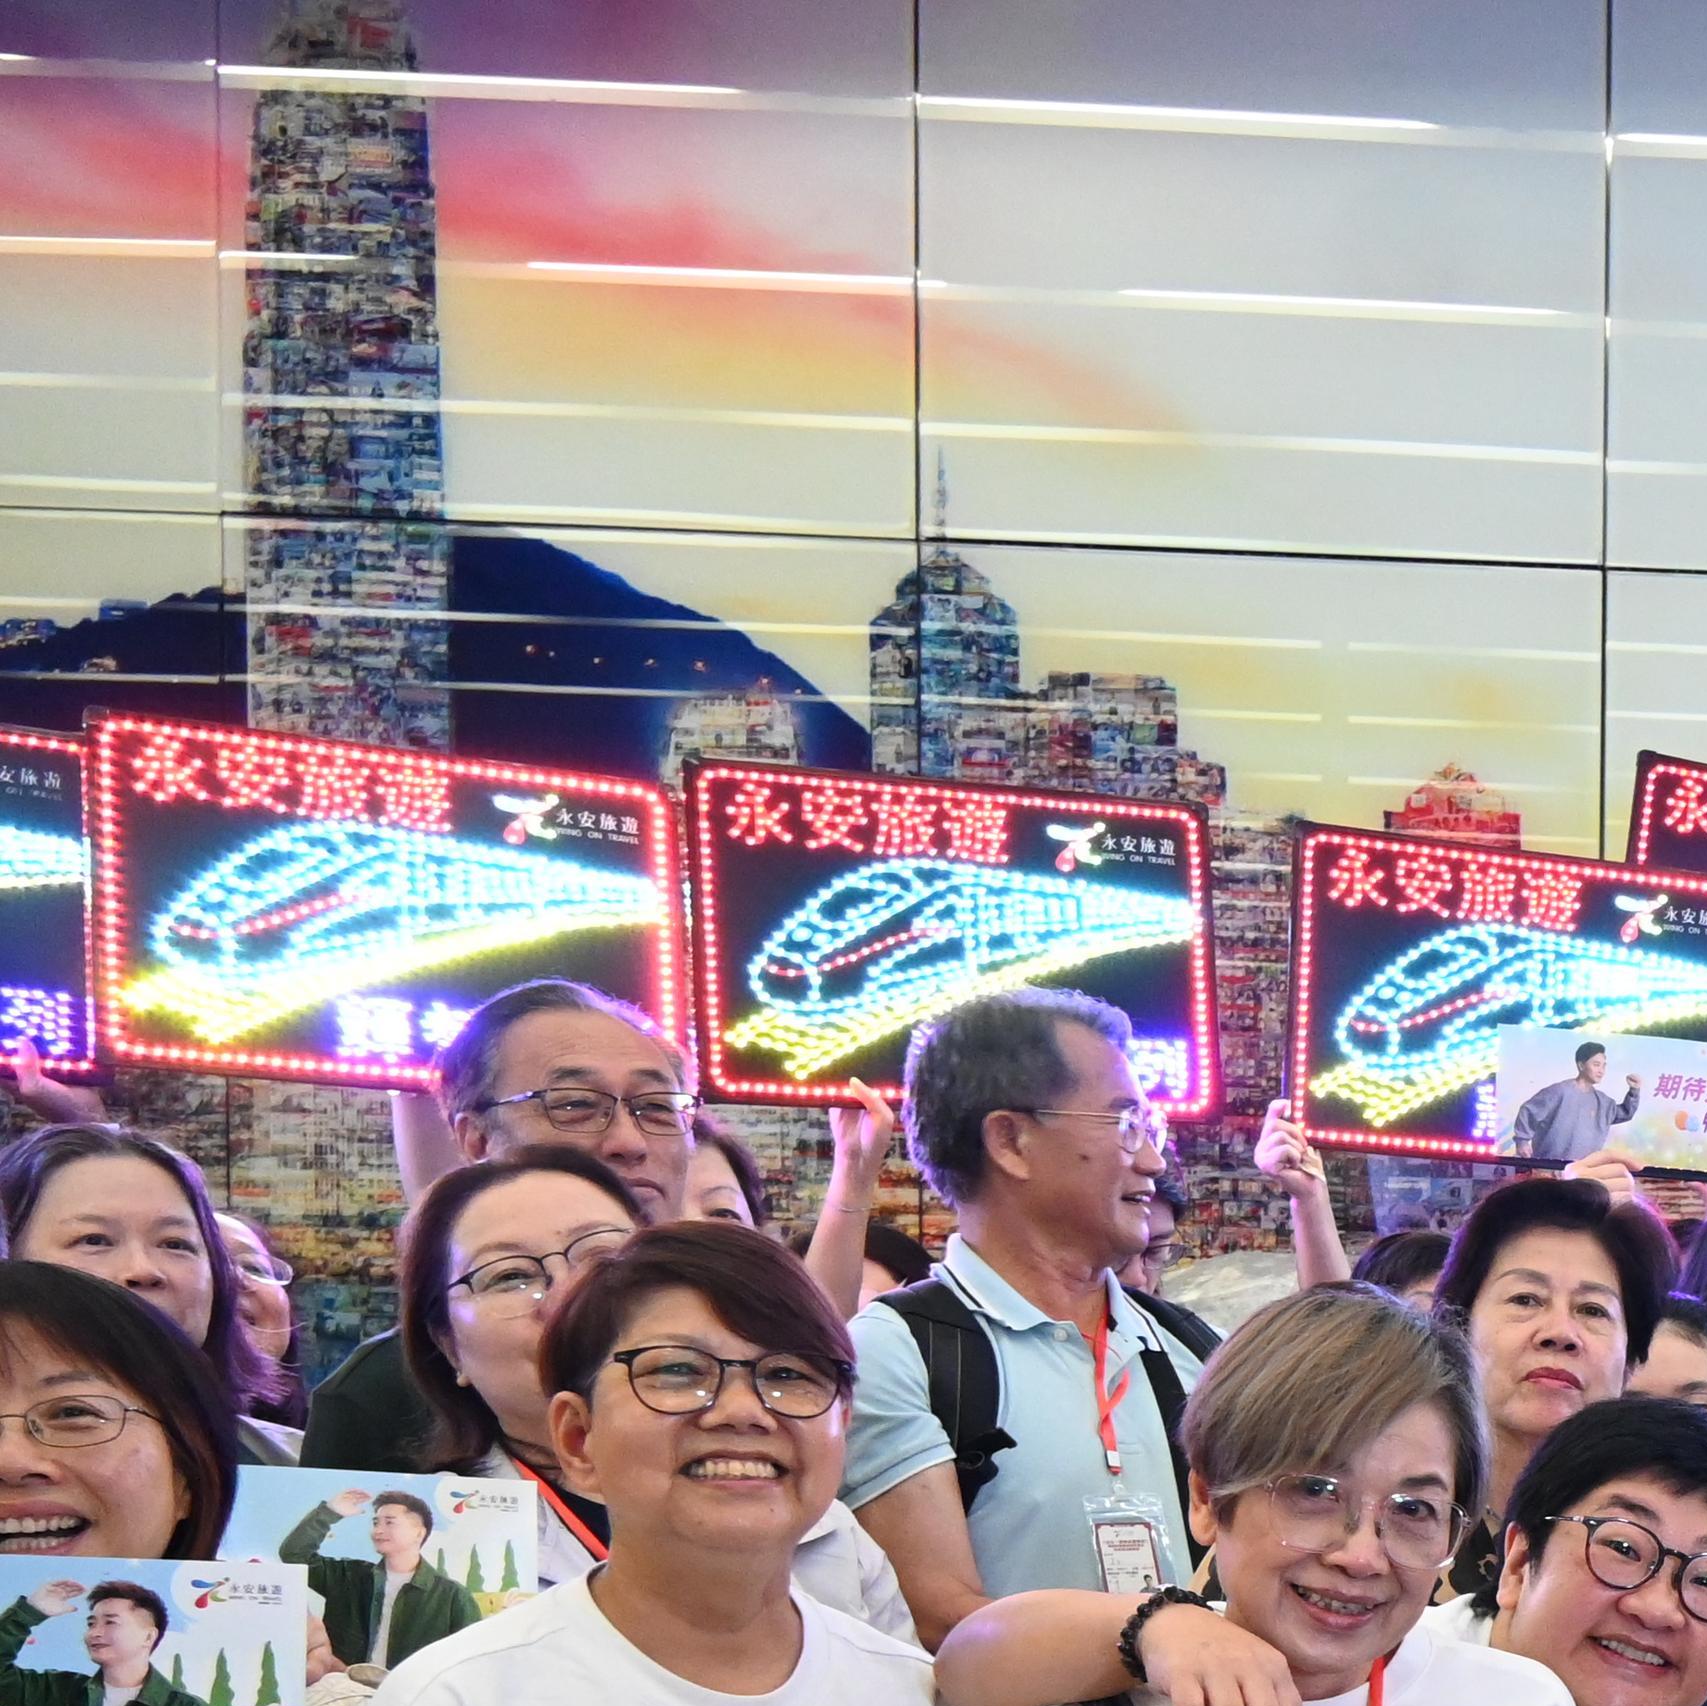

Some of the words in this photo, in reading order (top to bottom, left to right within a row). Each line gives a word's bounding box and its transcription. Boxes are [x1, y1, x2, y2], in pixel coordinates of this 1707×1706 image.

[0, 764, 62, 790] 安旅遊
[556, 807, 640, 836] 永安旅遊
[725, 781, 1009, 864] 永安旅遊
[555, 827, 583, 838] WING
[588, 829, 602, 840] ON
[608, 832, 640, 845] TRAVEL
[1102, 833, 1177, 857] 永安旅遊
[1102, 851, 1126, 863] WING
[1129, 854, 1145, 865] ON
[1147, 855, 1177, 867] TRAVEL
[1327, 846, 1584, 932] 永安旅遊
